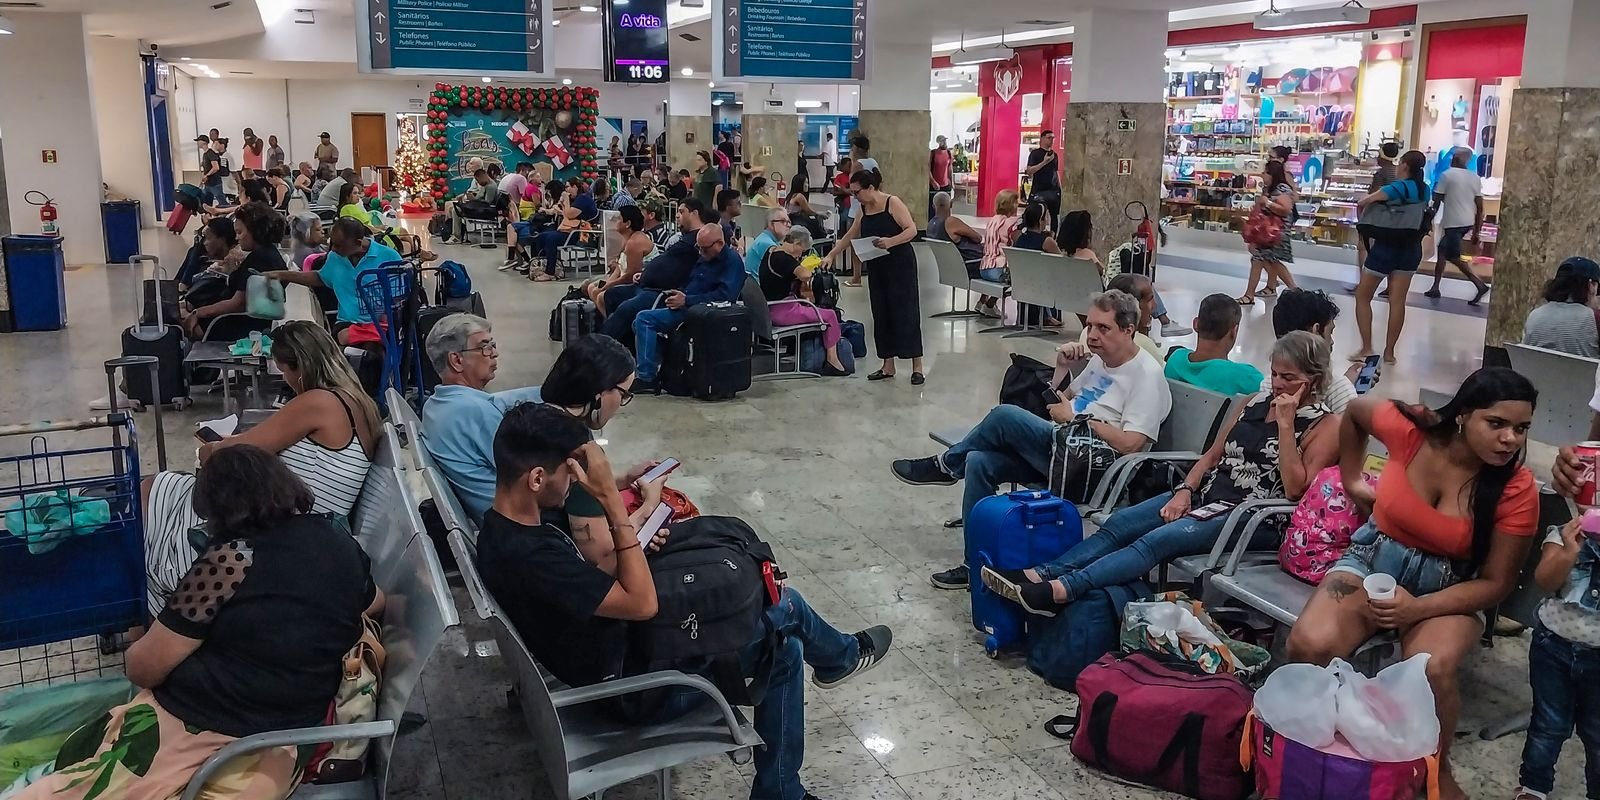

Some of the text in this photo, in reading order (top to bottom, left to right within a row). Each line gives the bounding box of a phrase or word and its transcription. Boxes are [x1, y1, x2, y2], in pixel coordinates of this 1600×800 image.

[747, 6, 780, 14] Bebedouros
[621, 13, 661, 27] A vida
[629, 65, 663, 78] 11:06
